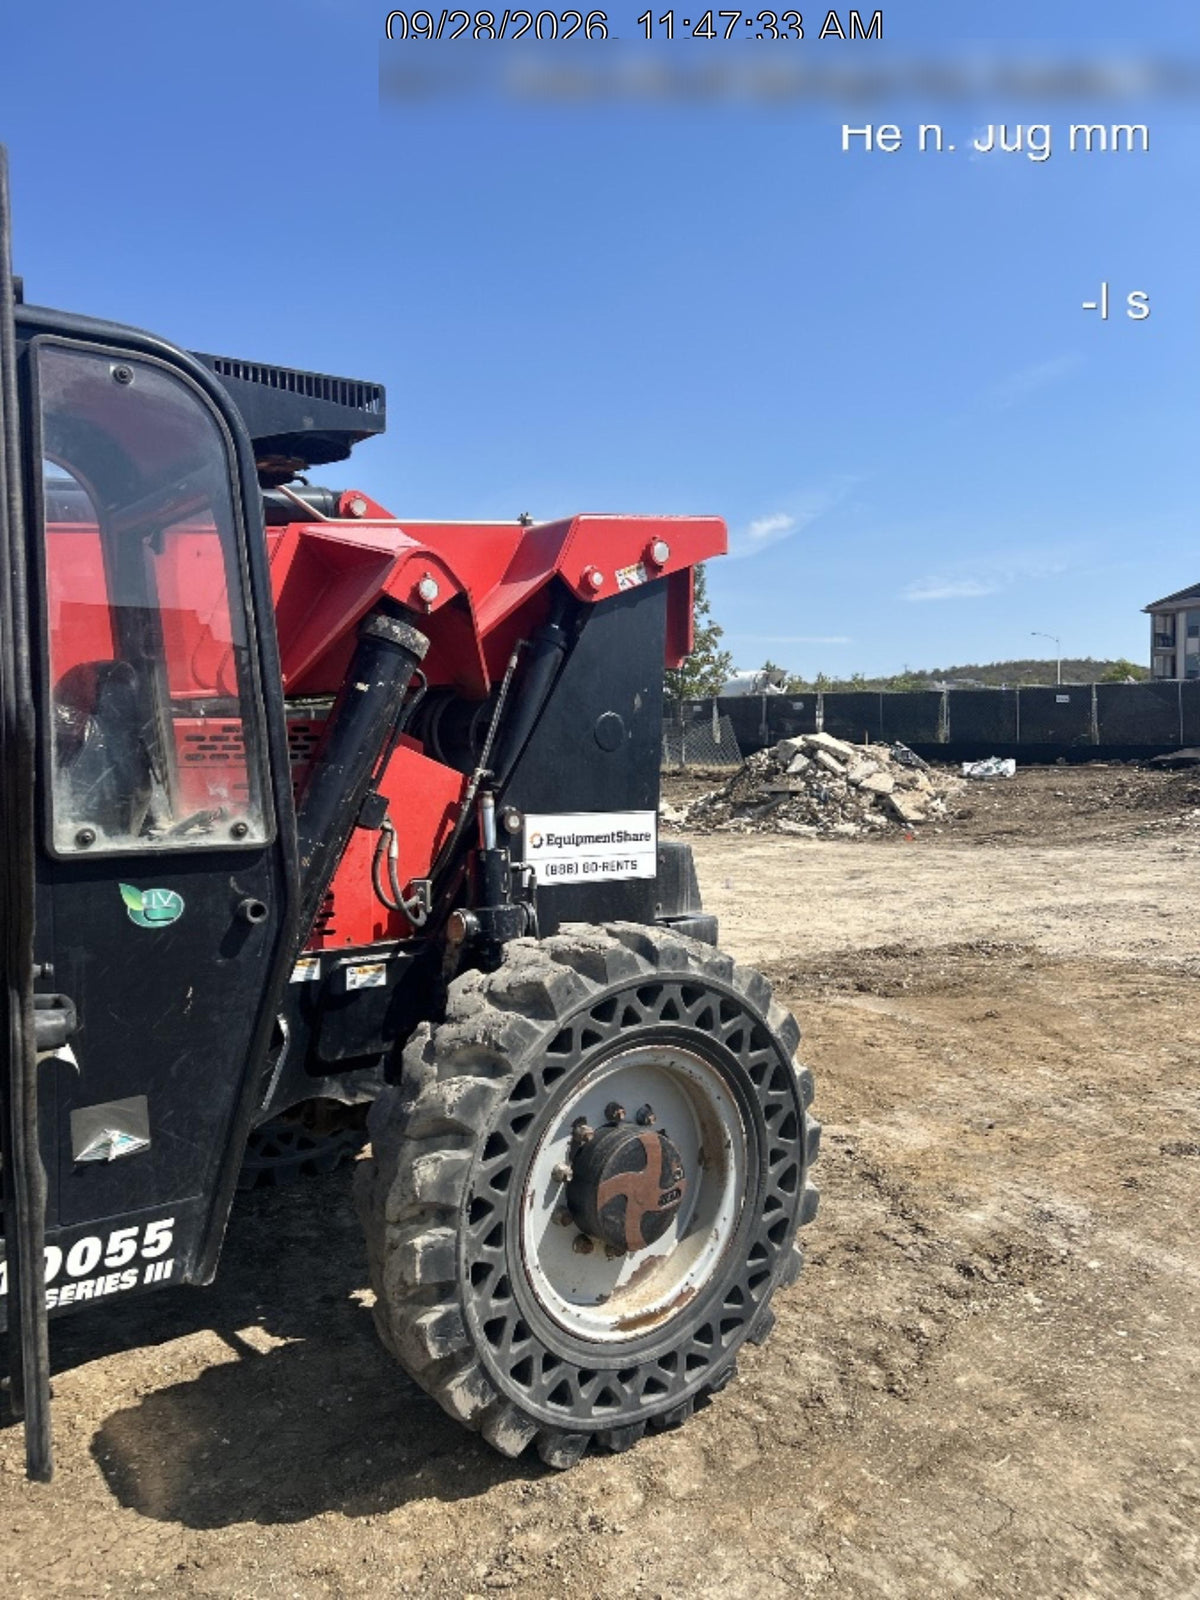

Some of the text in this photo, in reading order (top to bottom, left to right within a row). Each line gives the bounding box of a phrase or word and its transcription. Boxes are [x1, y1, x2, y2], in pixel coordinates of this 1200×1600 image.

[546, 830, 651, 848] EquipmentShare
[45, 1258, 175, 1310] SERIES III
